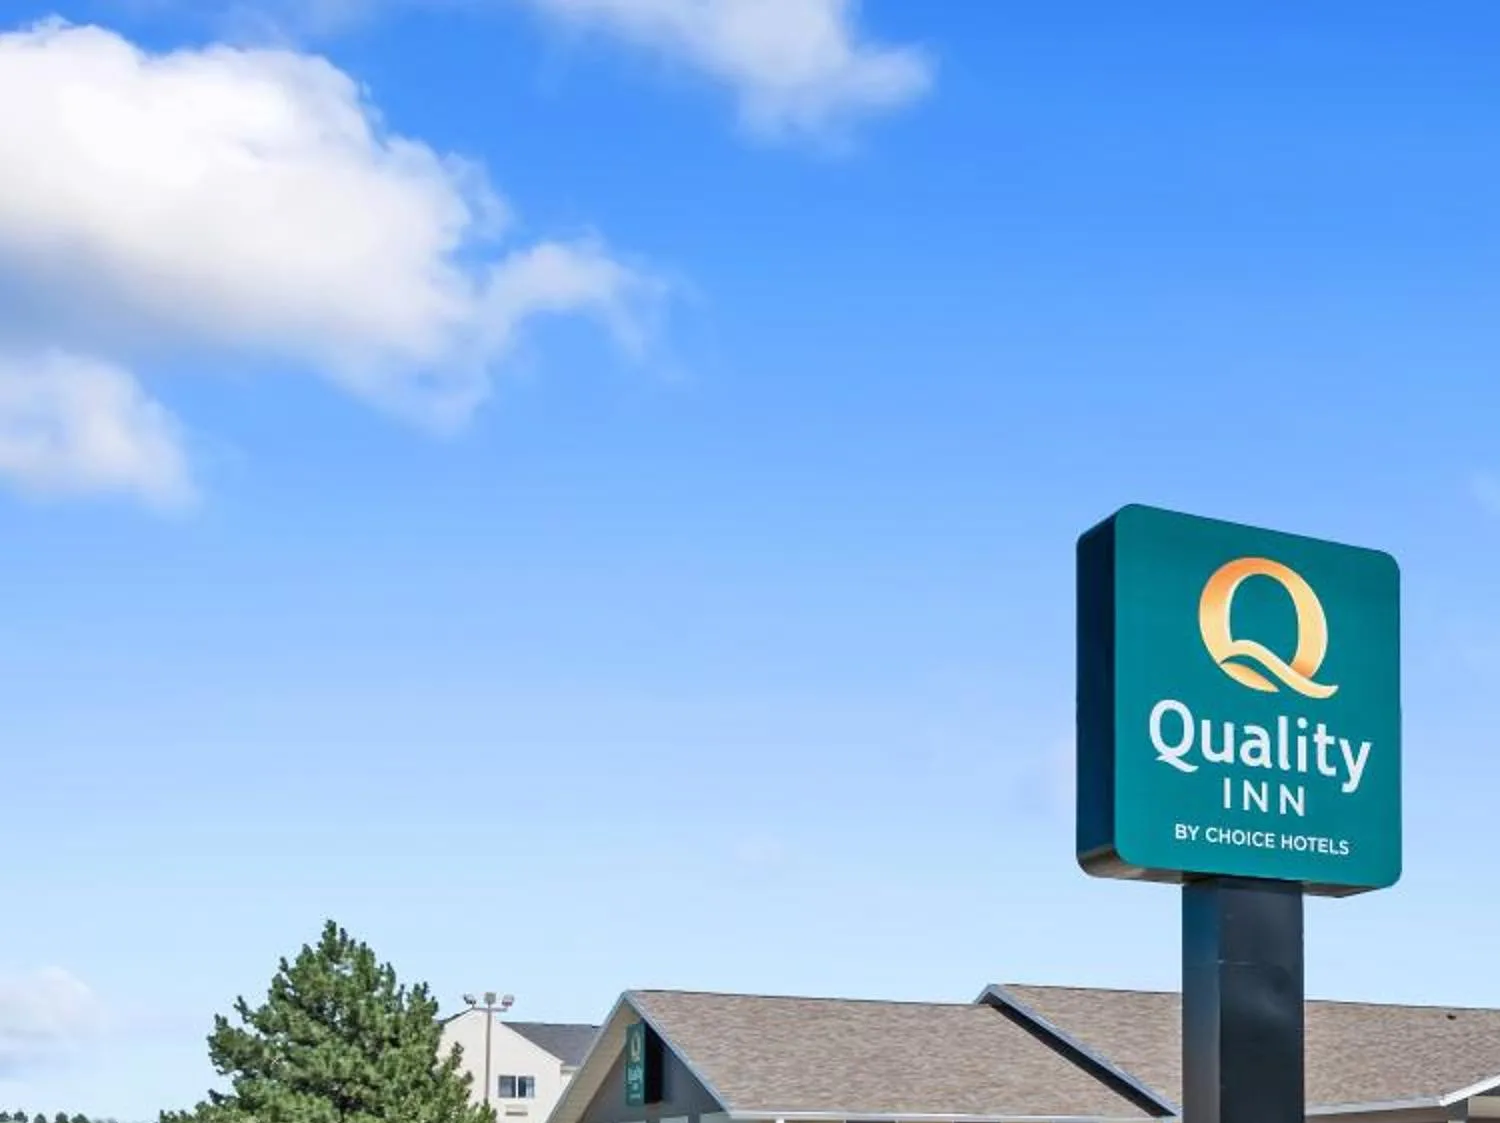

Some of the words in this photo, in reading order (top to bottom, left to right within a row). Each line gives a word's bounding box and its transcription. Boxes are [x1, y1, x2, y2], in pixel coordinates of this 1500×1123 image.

[1199, 557, 1339, 699] Q
[1149, 699, 1372, 793] Quality
[1223, 778, 1305, 817] INN
[1175, 824, 1200, 841] BY
[1205, 827, 1275, 850] CHOICE
[1281, 834, 1350, 856] HOTELS
